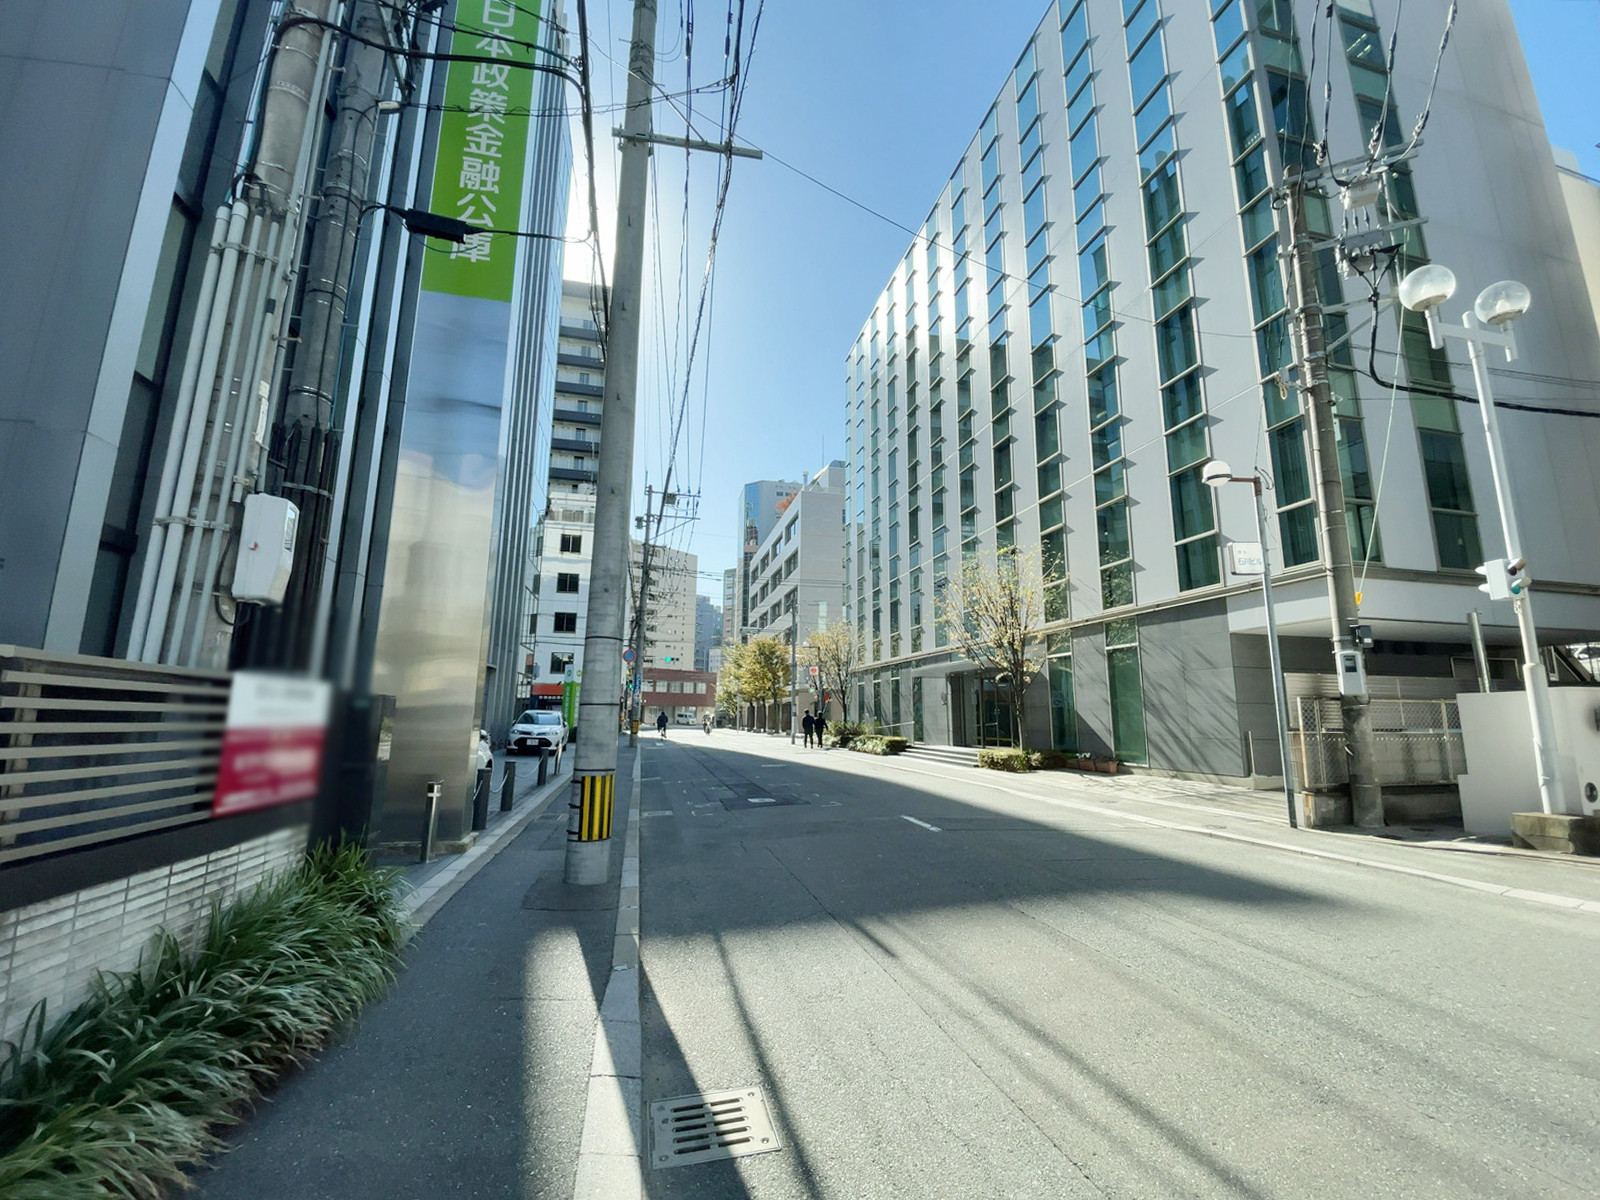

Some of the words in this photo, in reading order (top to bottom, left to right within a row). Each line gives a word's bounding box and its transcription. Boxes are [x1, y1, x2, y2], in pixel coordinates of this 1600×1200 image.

[450, 0, 516, 263] 日本政策金融公庫
